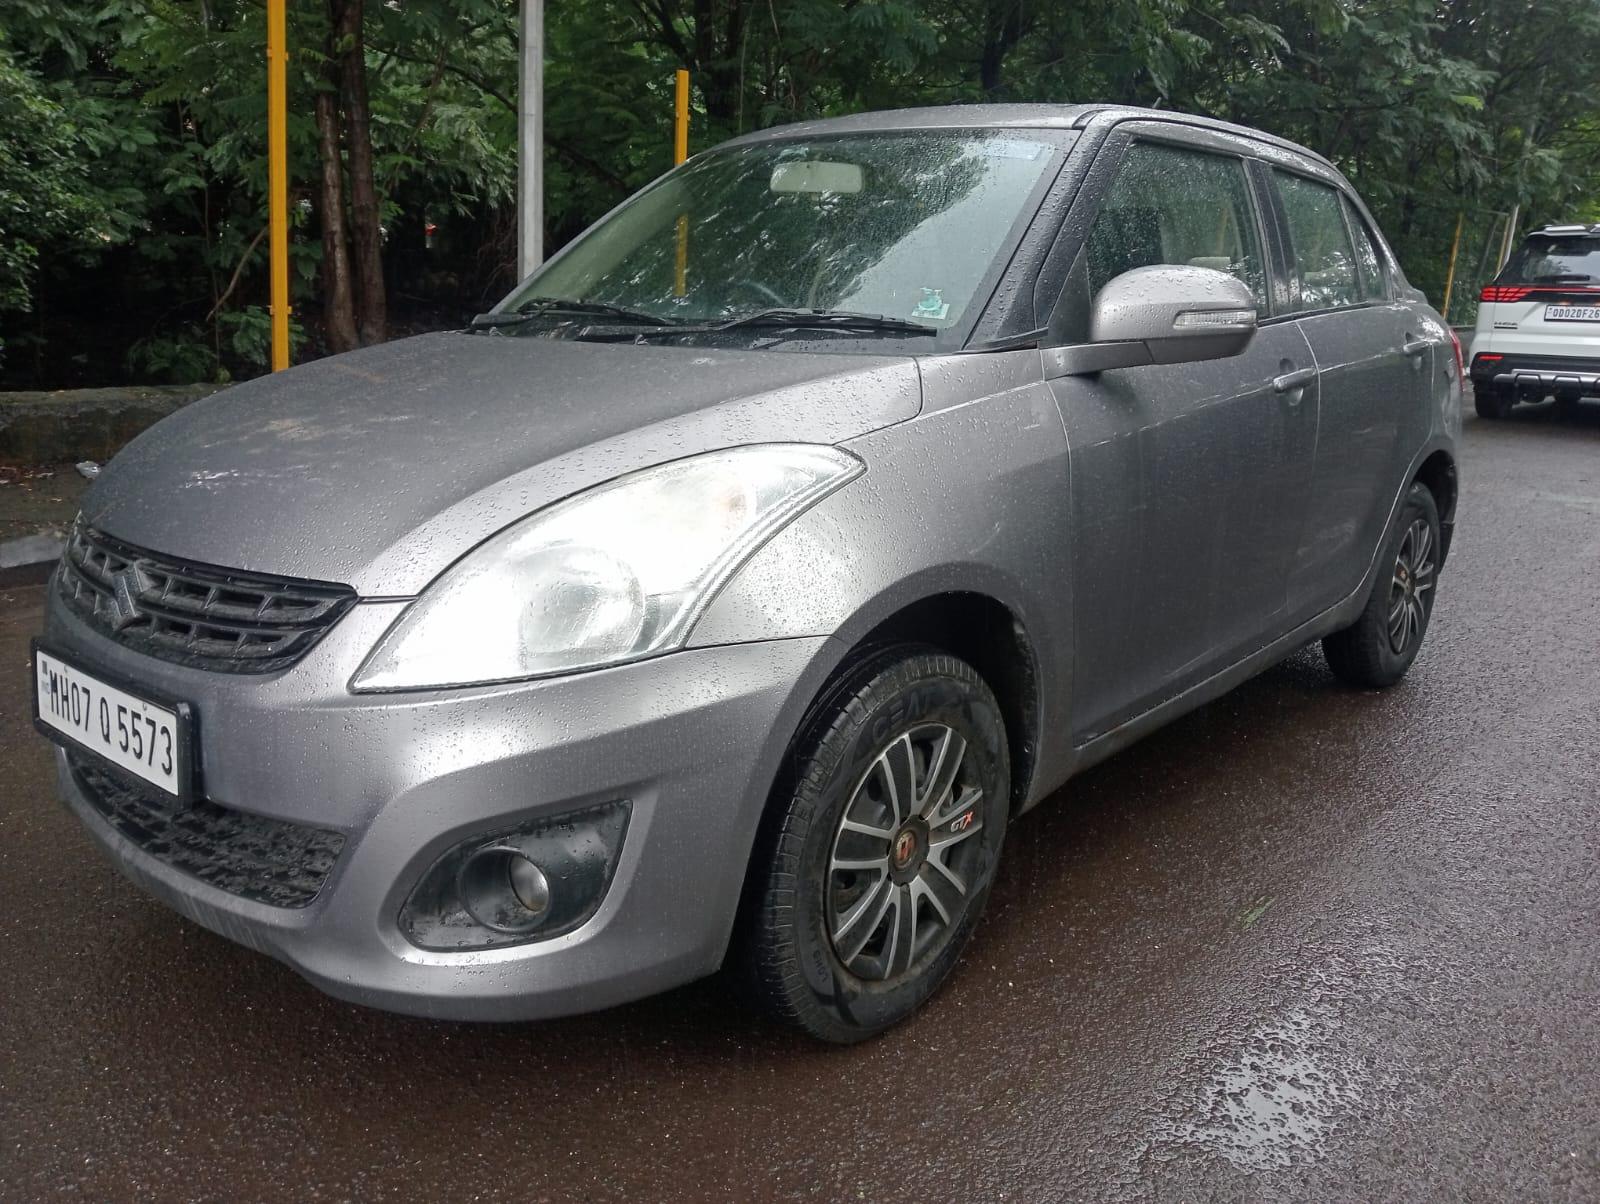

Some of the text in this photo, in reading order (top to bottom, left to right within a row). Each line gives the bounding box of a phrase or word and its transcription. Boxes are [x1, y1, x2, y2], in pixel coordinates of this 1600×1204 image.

[49, 670, 173, 776] MH07 Q 5573
